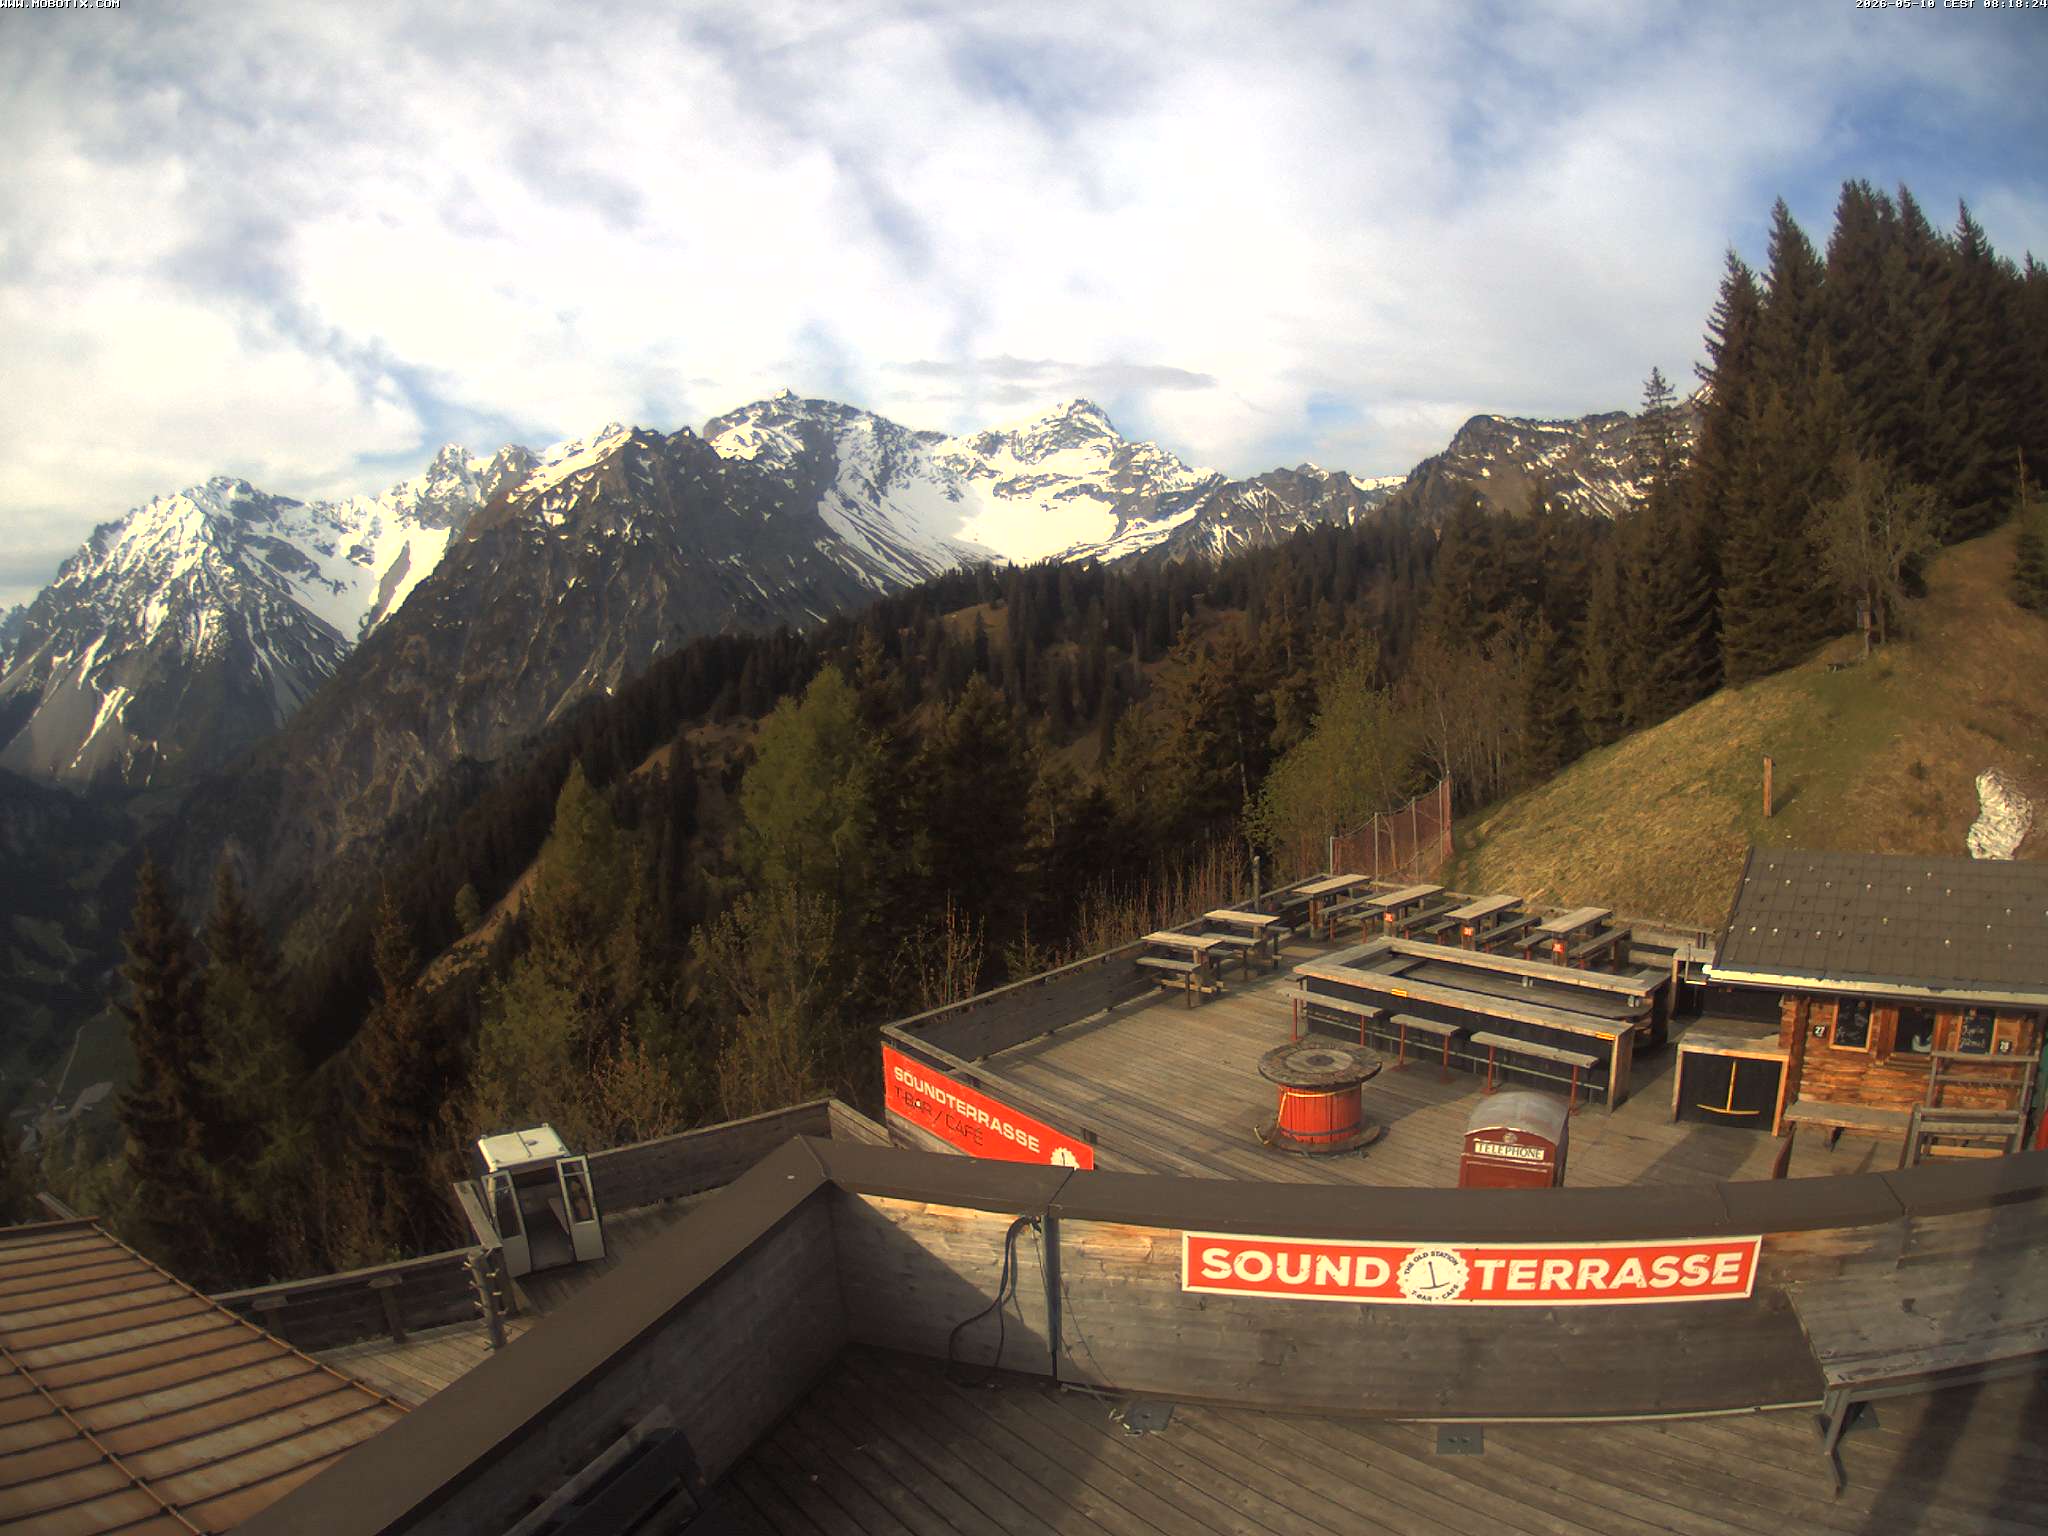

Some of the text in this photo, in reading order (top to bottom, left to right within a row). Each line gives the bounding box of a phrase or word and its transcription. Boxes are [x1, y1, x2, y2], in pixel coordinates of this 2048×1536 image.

[893, 1066, 1041, 1153] SOUNDTERRASSE
[1478, 1143, 1542, 1159] TELEPHONE
[1201, 1247, 1391, 1288] SOUND
[1404, 1250, 1459, 1275] THE OLD STATION
[1474, 1252, 1743, 1291] TERRASSE
